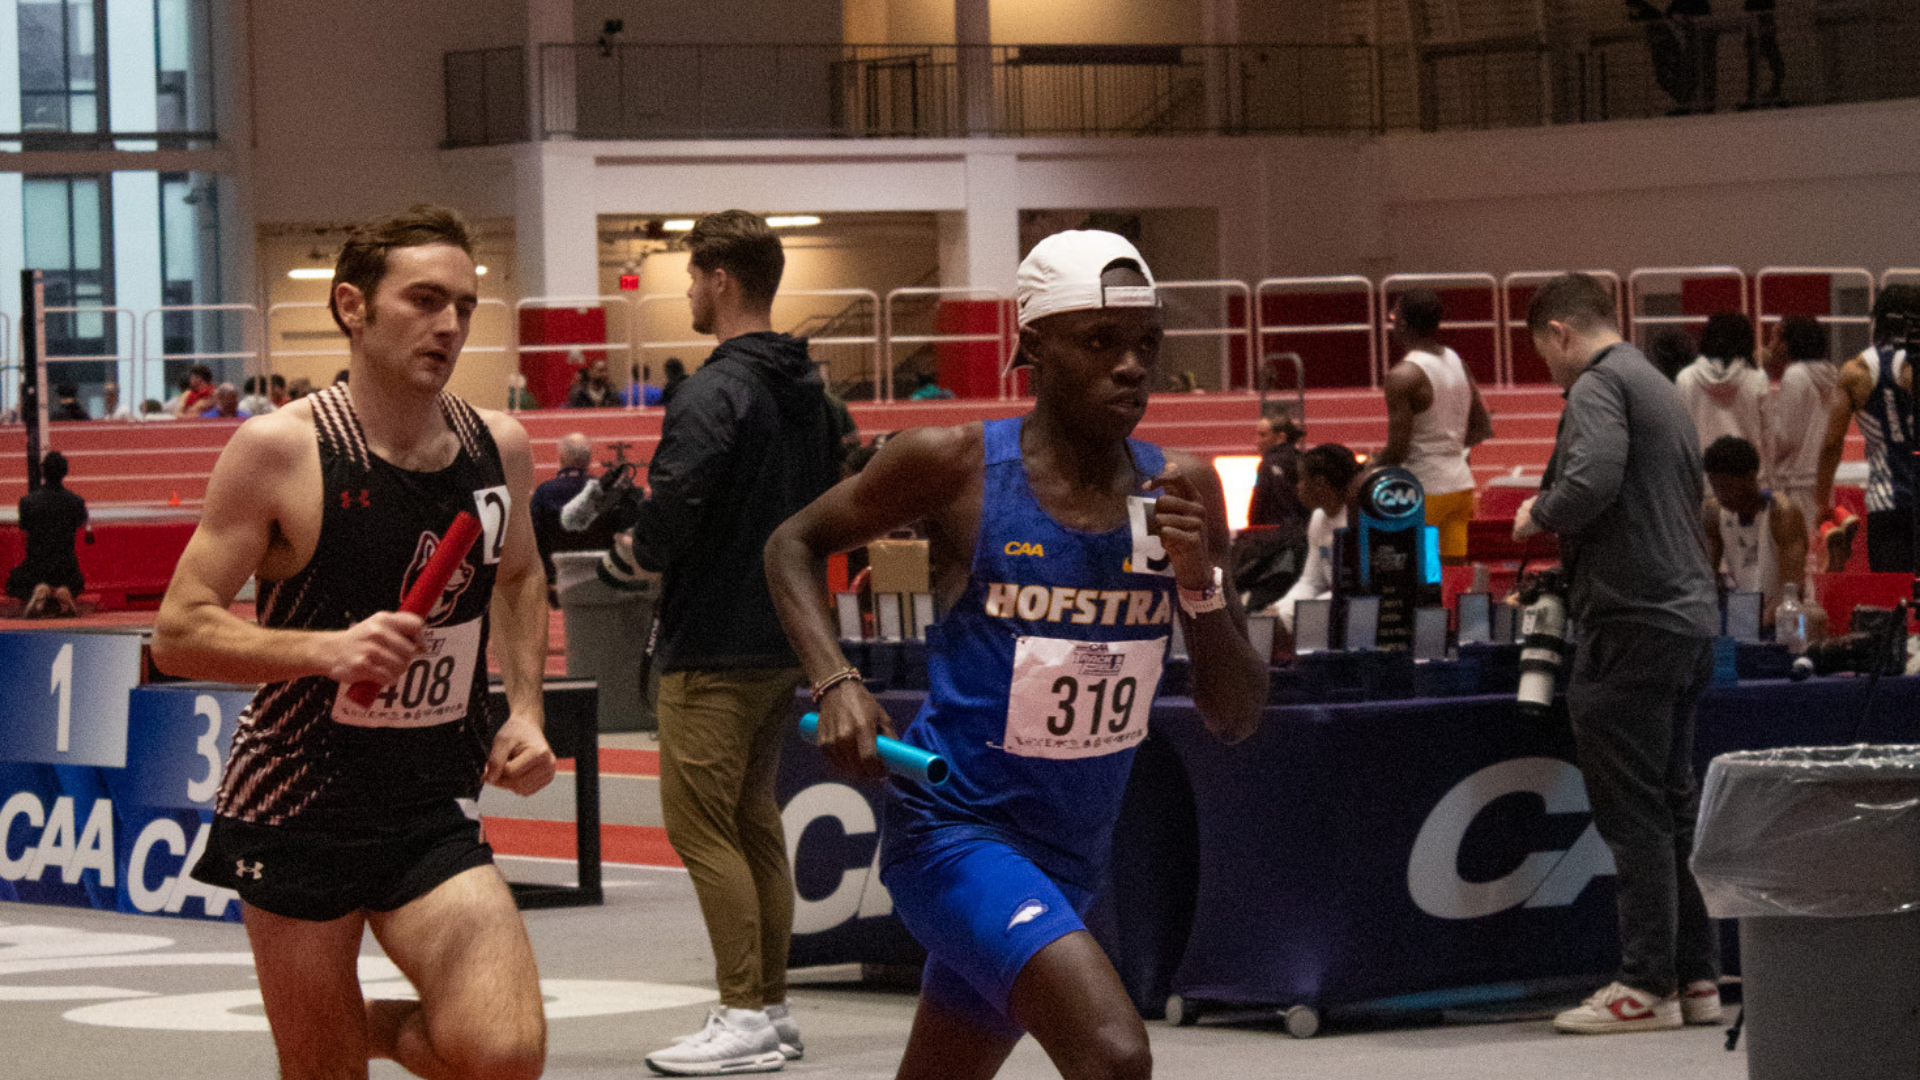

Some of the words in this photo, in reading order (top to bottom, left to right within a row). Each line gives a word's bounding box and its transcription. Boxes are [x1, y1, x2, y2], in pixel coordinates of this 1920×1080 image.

[1004, 541, 1044, 557] CAA
[985, 582, 1172, 625] HOFSTRA
[50, 643, 73, 751] 1
[1047, 675, 1137, 736] 319
[187, 694, 222, 802] 3
[0, 791, 116, 888] CAA
